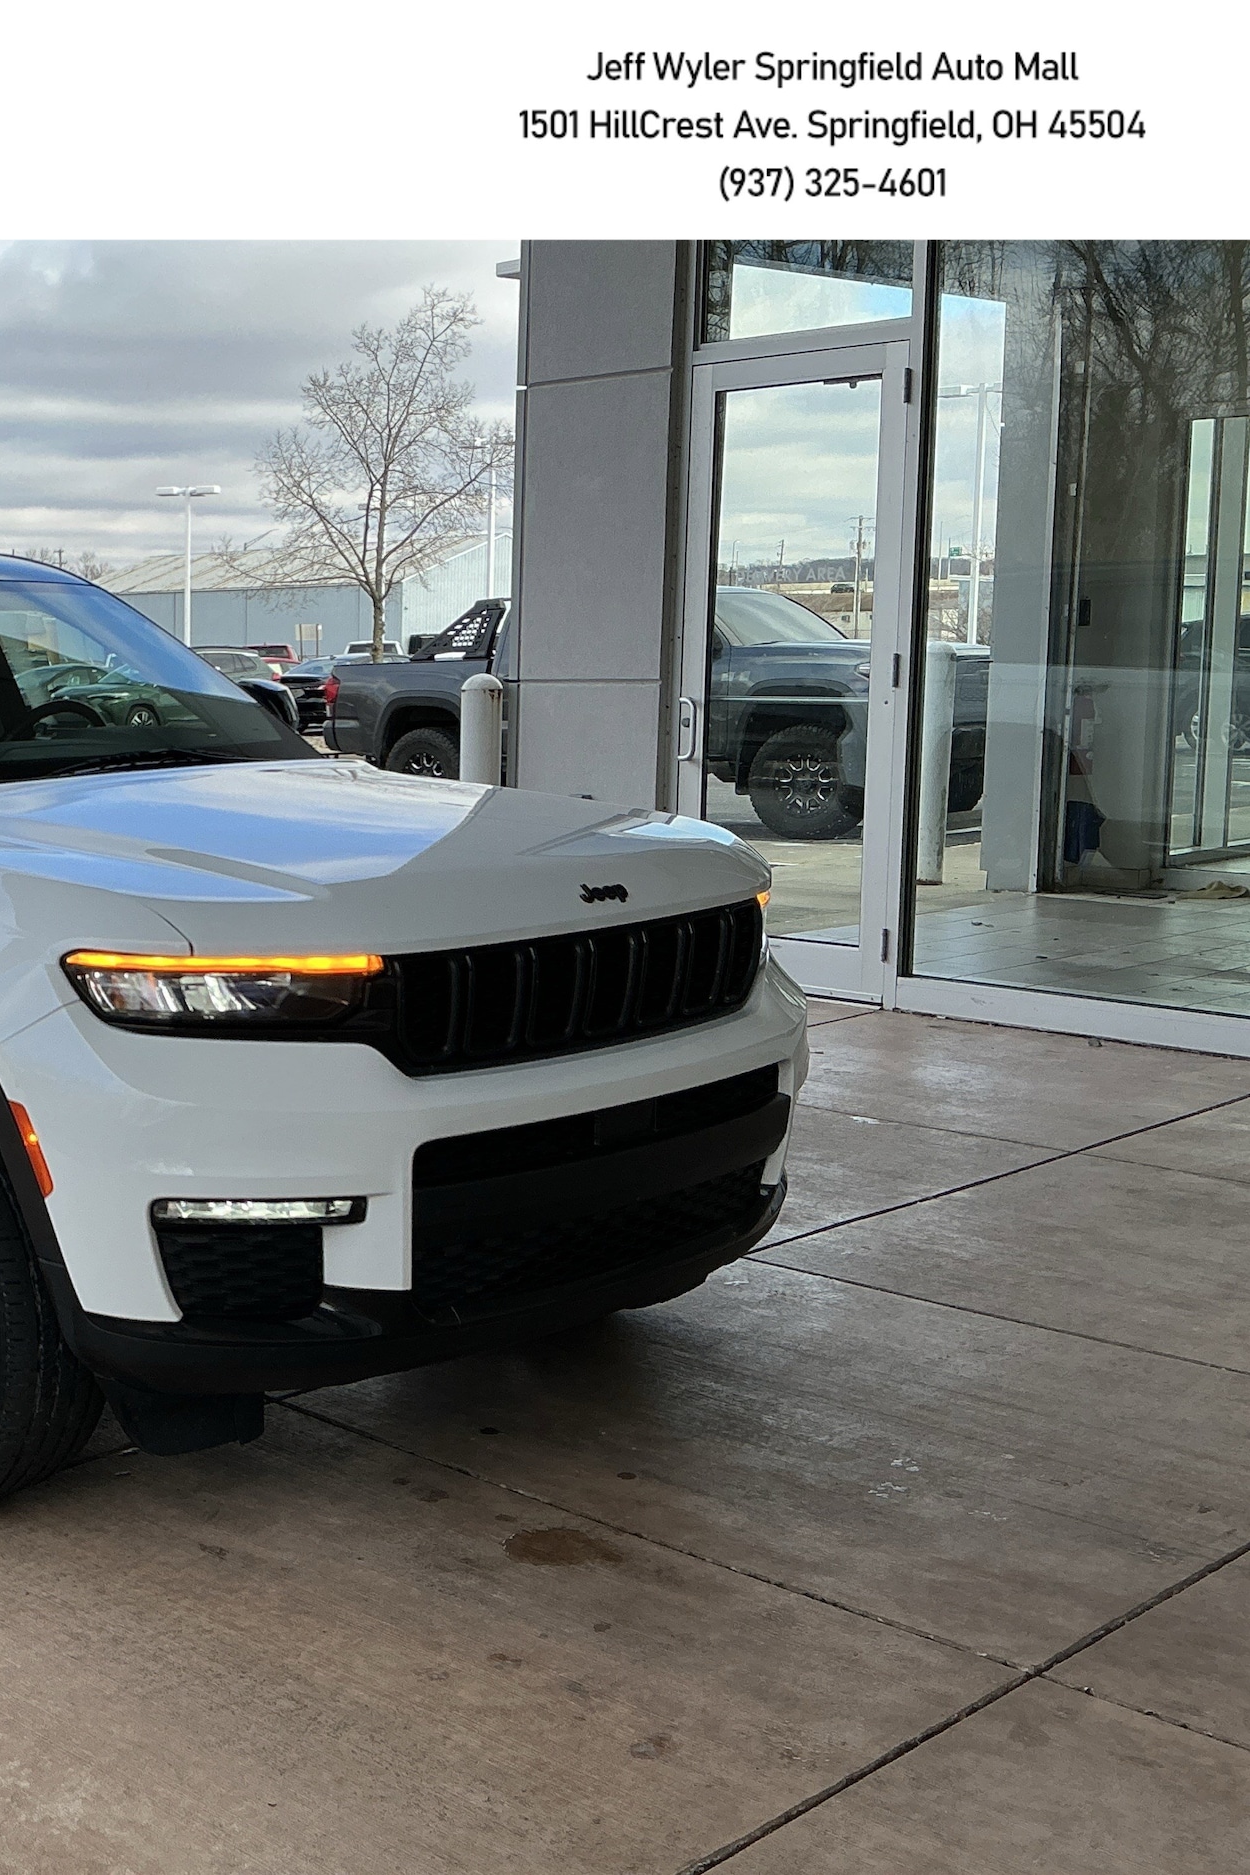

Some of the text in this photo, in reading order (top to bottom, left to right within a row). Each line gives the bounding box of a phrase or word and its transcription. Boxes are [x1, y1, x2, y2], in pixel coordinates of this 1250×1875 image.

[736, 566, 846, 582] DEVERY AREA
[579, 883, 629, 904] Jeep
